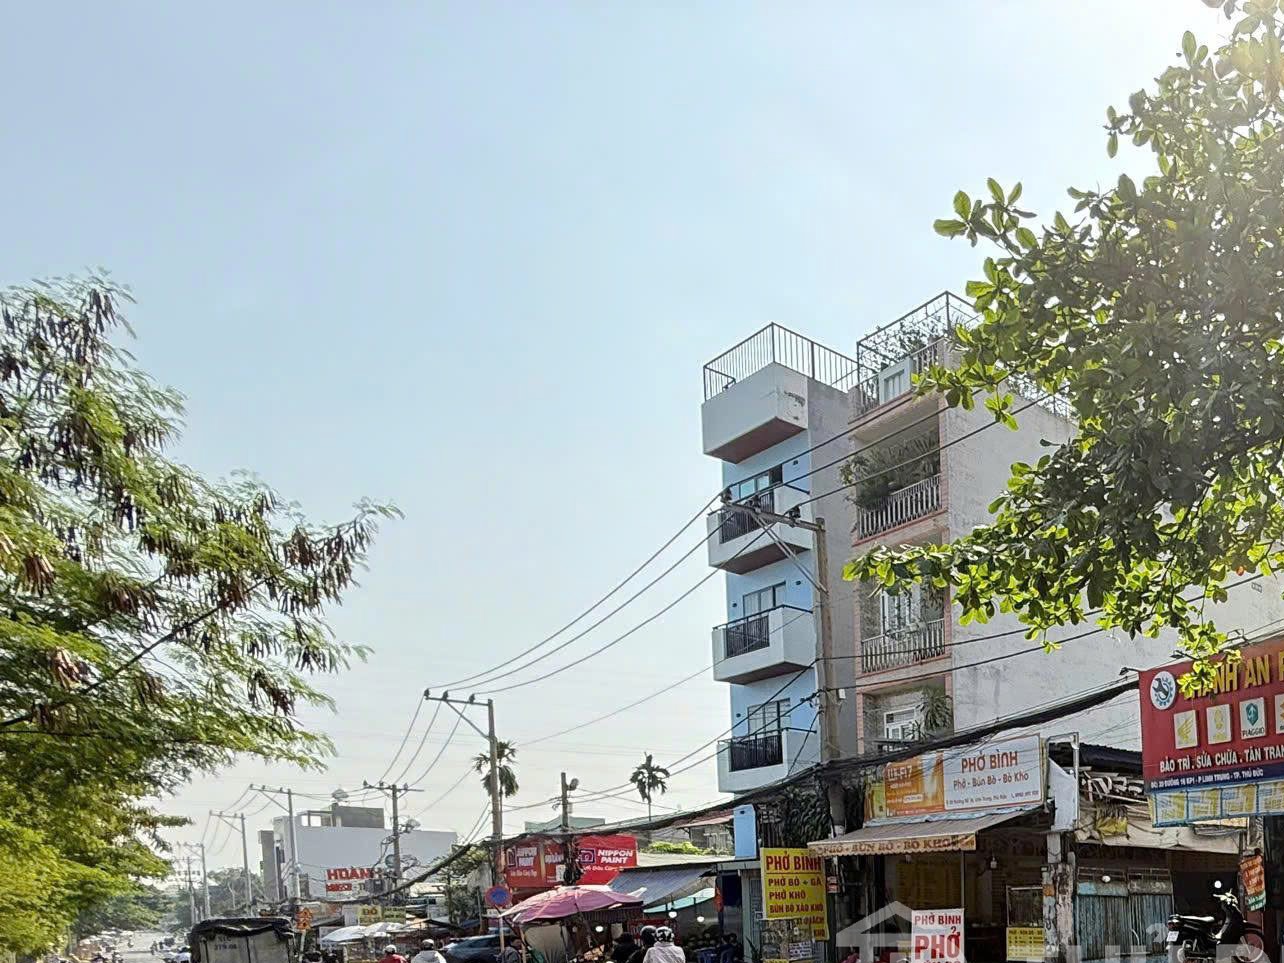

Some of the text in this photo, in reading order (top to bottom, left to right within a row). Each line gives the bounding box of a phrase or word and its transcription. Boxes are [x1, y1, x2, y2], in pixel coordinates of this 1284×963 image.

[1244, 654, 1270, 689] AN
[961, 748, 1018, 774] PHỞ BÌNH
[1160, 755, 1176, 773] BẢO
[1179, 754, 1191, 771] TRÌ
[1196, 750, 1212, 768] SỬA
[1215, 748, 1238, 765] CHỮA
[597, 848, 633, 858] NIPPON
[600, 856, 628, 865] PAINT
[766, 850, 822, 871] PHỞ BÌNH
[914, 912, 962, 926] PHỞ BÌNH
[914, 926, 961, 960] PHỞ
